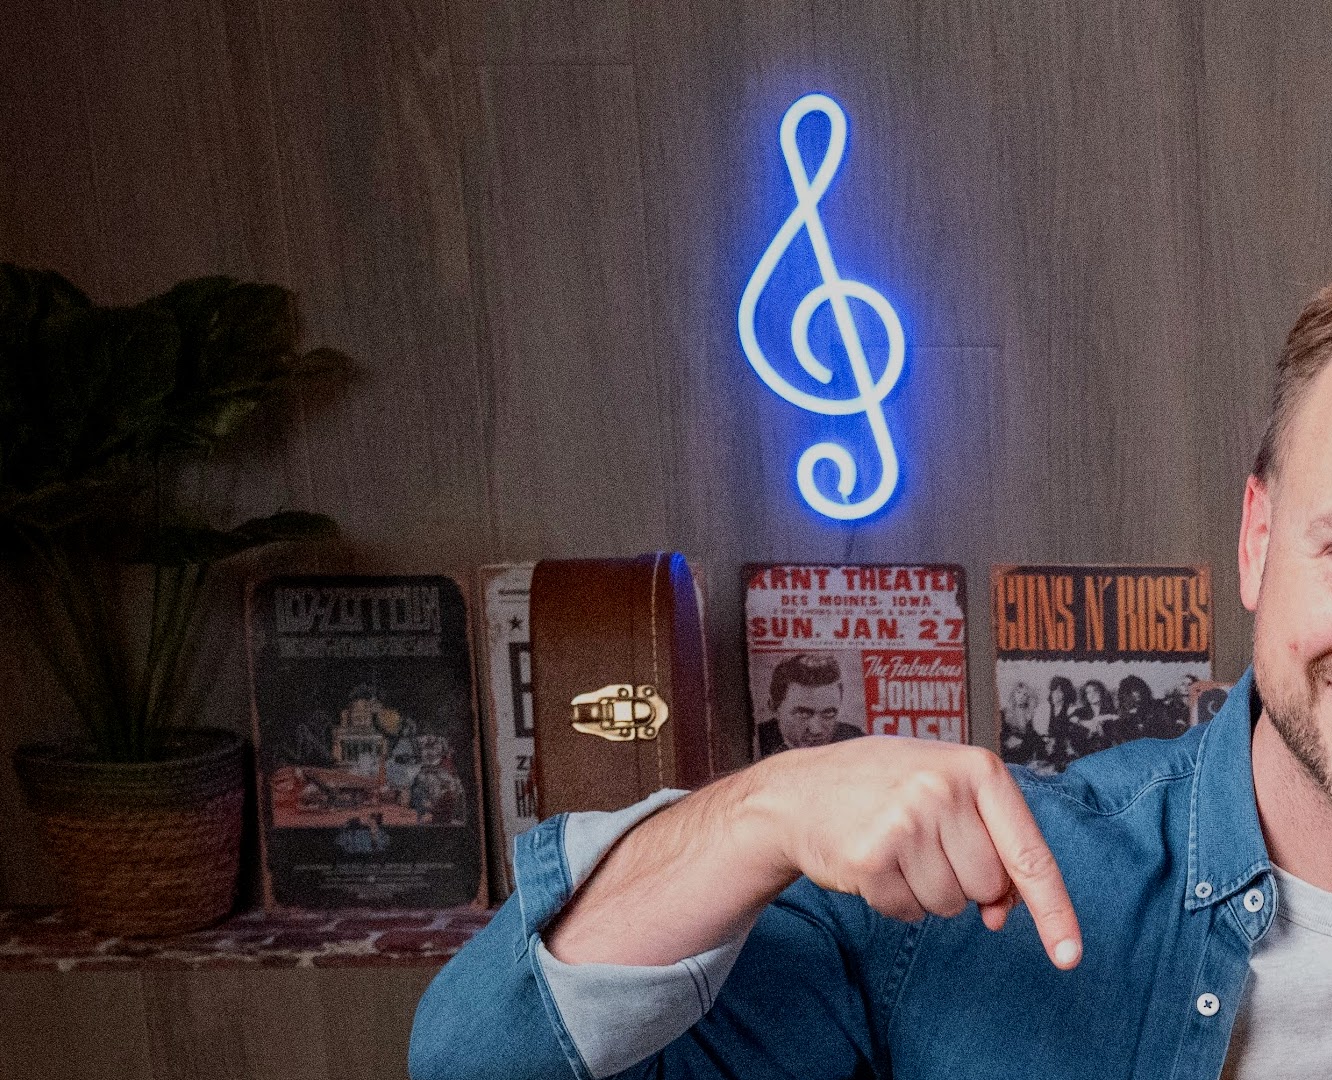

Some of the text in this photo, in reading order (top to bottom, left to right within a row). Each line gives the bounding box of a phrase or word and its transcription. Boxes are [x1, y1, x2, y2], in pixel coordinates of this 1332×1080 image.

[782, 595, 808, 606] DES
[892, 595, 932, 607] IOWA
[998, 575, 1075, 651] GUNS
[1117, 575, 1208, 651] ROSES
[751, 617, 821, 639] SUN.
[834, 618, 905, 640] JAN.
[864, 655, 962, 678] The Fabulous
[871, 677, 962, 711] JOHNNY
